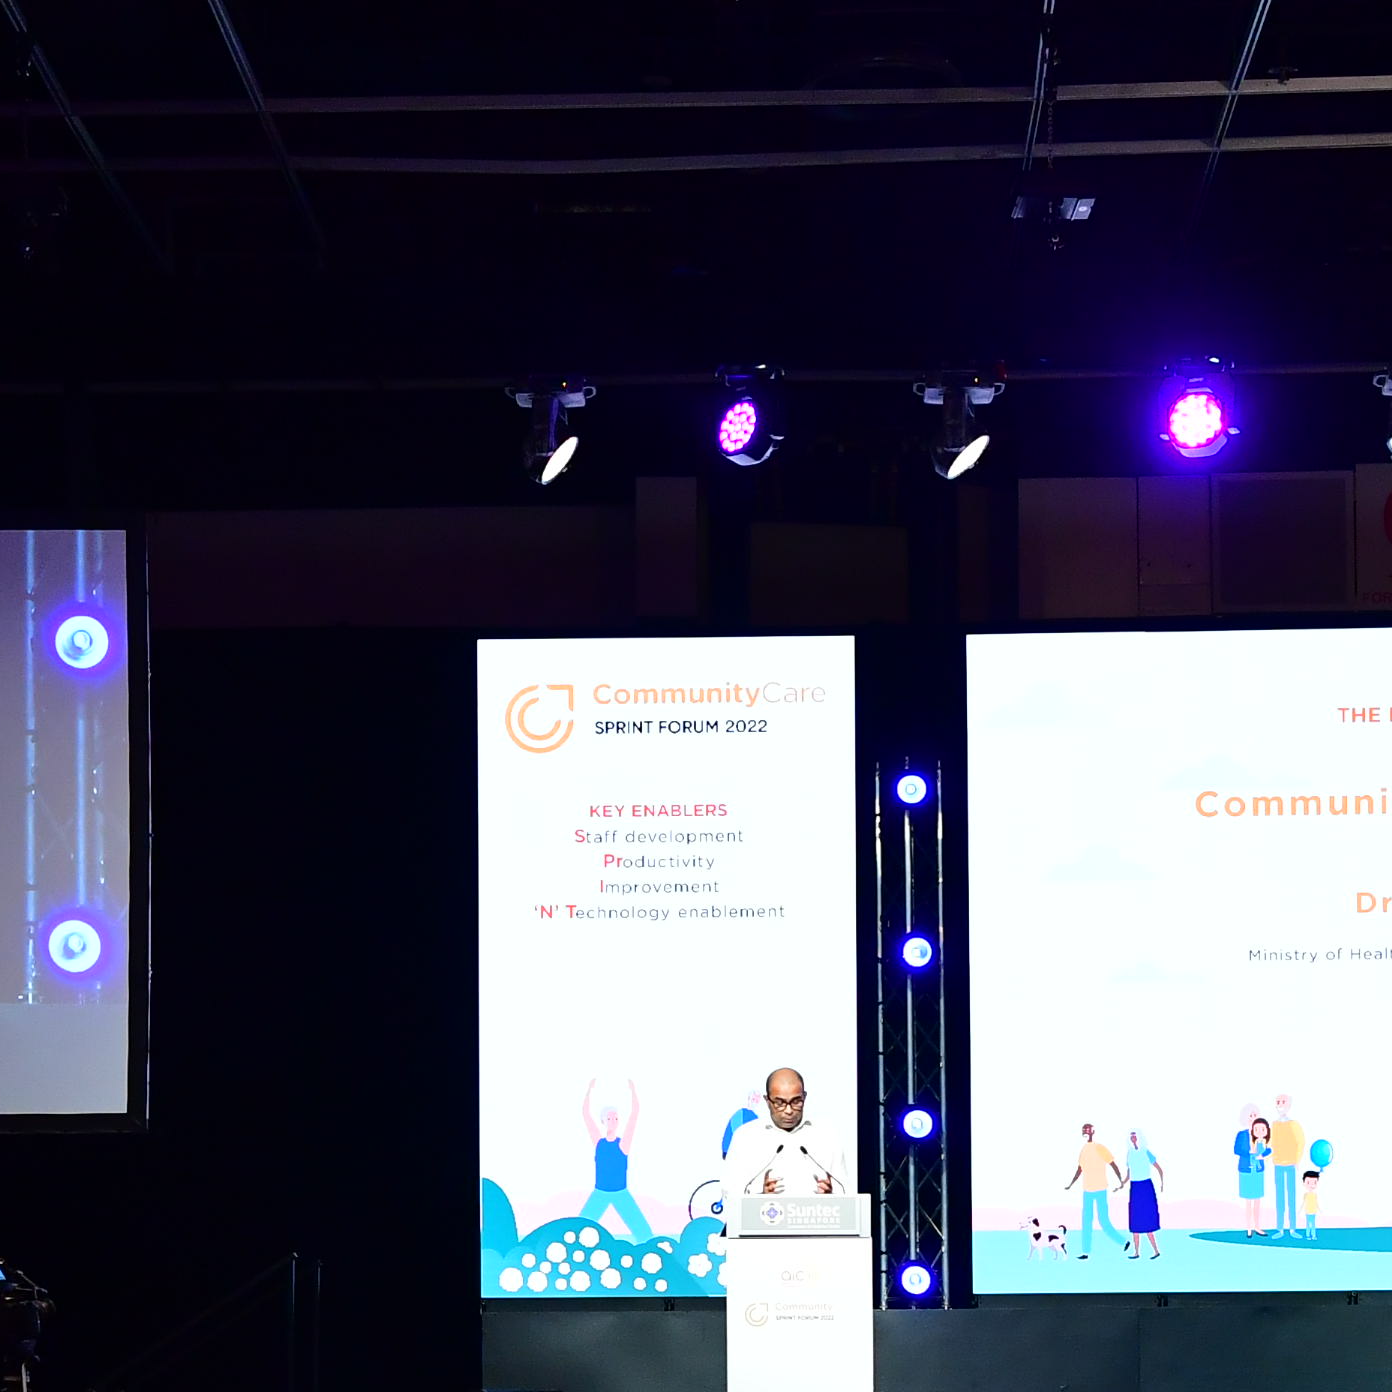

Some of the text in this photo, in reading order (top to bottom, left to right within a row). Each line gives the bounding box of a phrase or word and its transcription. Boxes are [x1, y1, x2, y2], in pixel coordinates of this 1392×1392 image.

[593, 681, 826, 707] CommunityCare
[1337, 706, 1382, 724] THE
[594, 719, 768, 735] SPRINT FORUM 2022
[589, 804, 728, 818] KEY ENABLERS
[574, 829, 743, 845] Staff development
[603, 854, 716, 870] Productivity
[599, 880, 720, 895] Improvement
[1355, 890, 1392, 914] Dr
[565, 904, 670, 921] Technology
[678, 905, 786, 919] enablement
[1248, 947, 1319, 964] Ministry
[1324, 947, 1343, 961] of
[787, 1203, 840, 1217] Suntec
